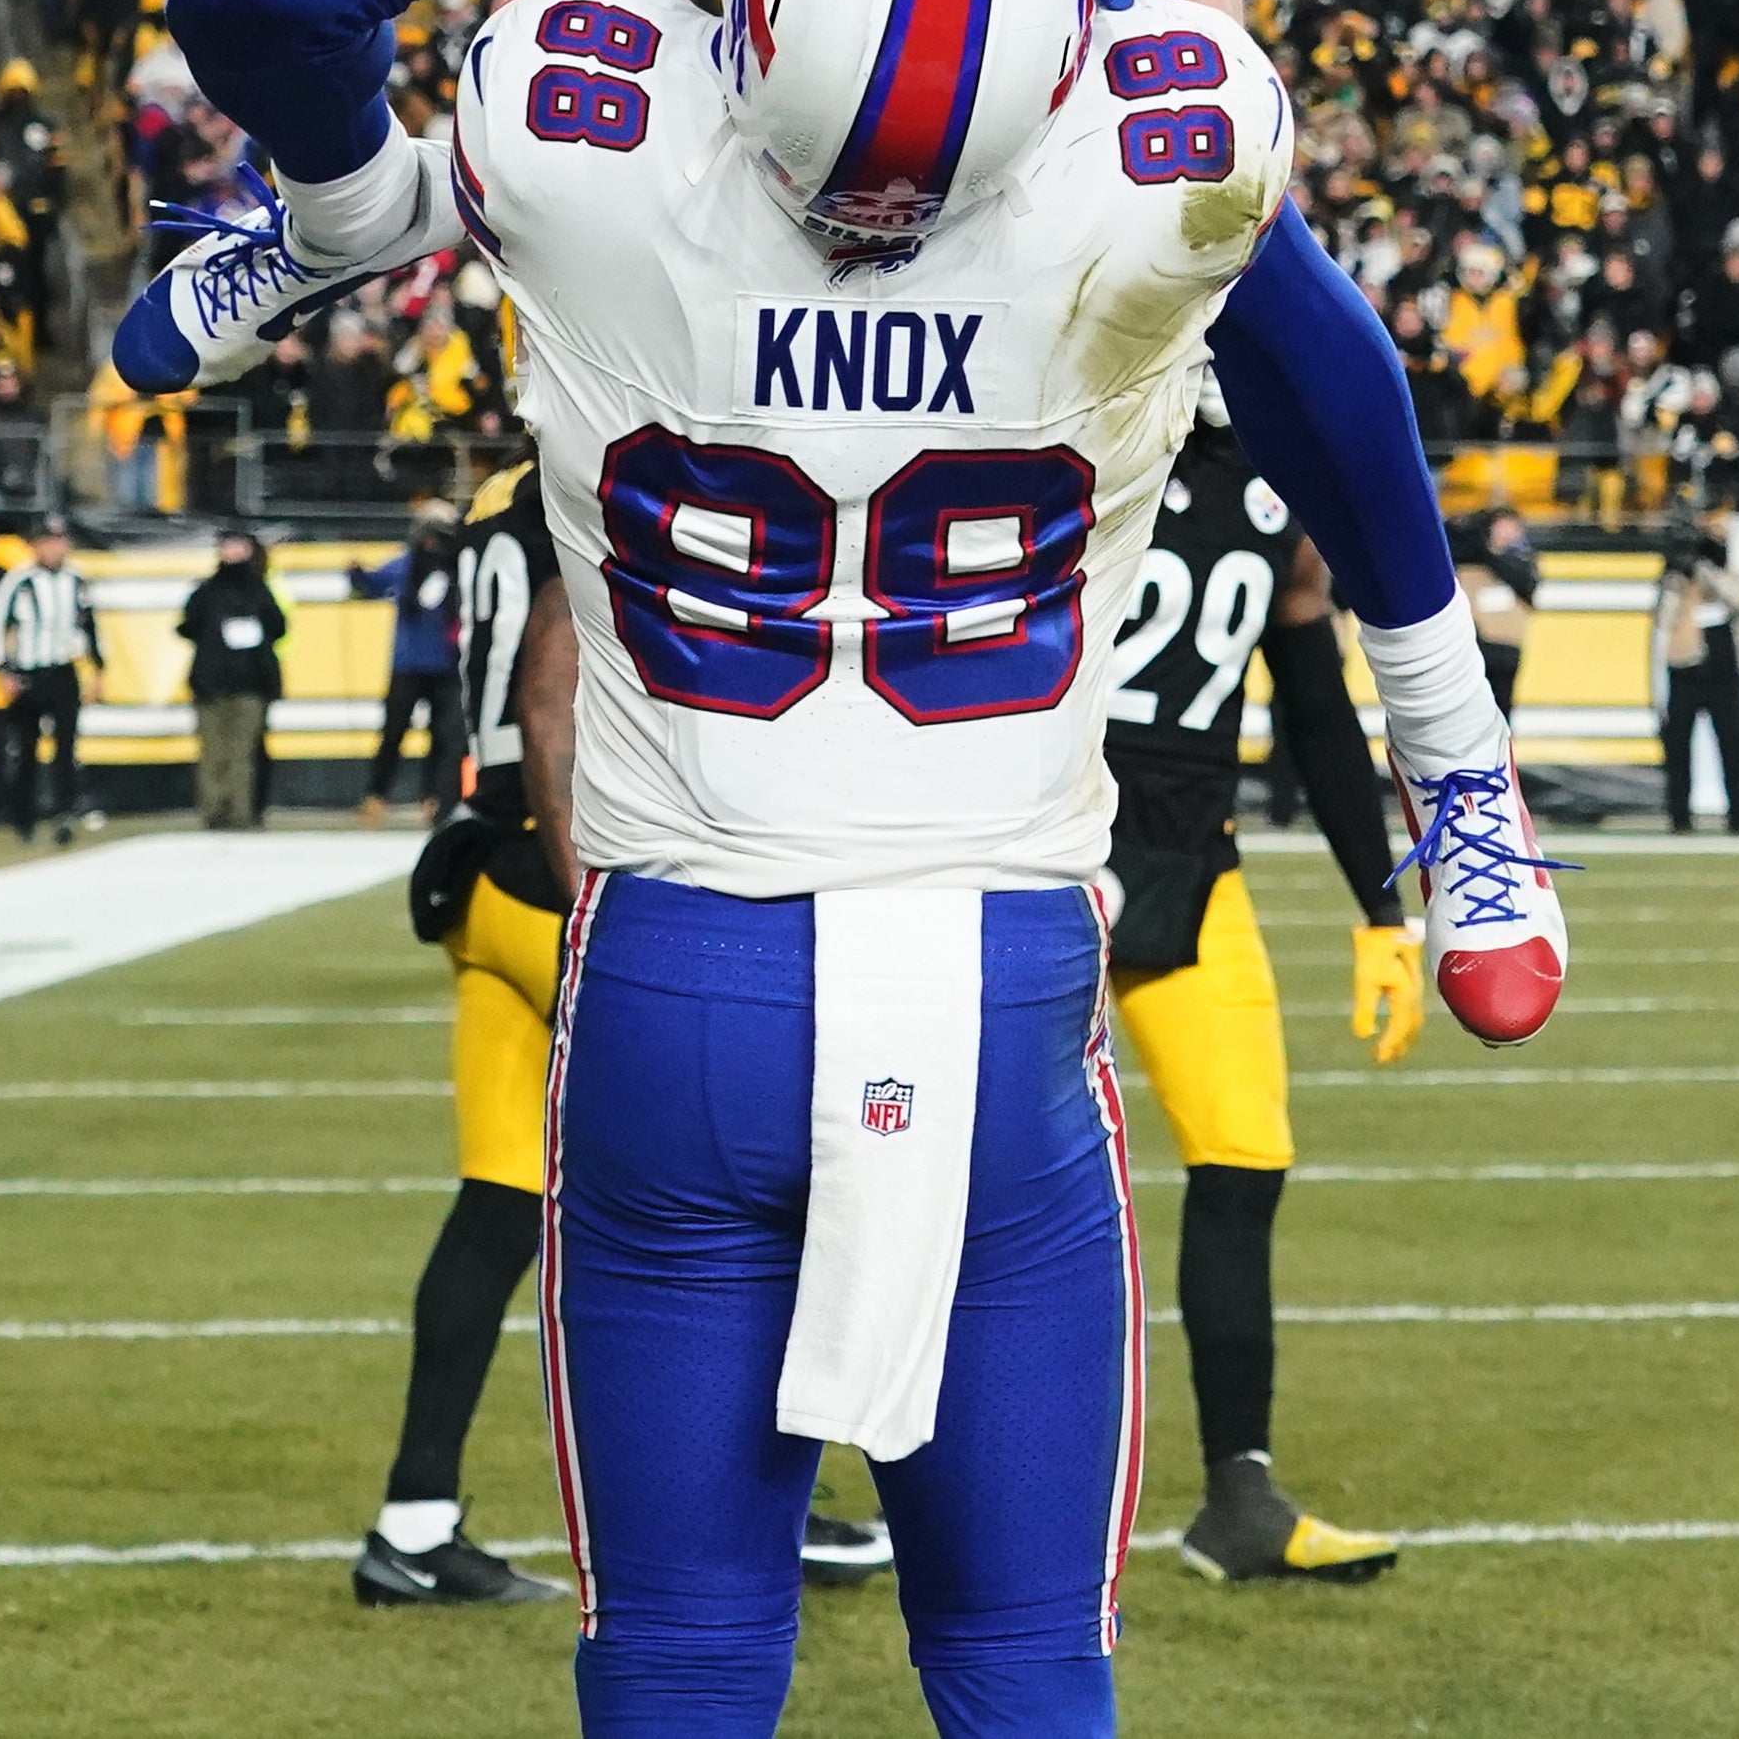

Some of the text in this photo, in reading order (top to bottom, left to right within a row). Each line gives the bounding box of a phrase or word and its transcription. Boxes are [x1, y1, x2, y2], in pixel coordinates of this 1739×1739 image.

[526, 0, 663, 153] 88
[1104, 30, 1235, 186] 88
[754, 306, 983, 414] KNOX
[597, 421, 1096, 726] 88
[1106, 548, 1274, 731] 29
[866, 1102, 907, 1131] NFL
